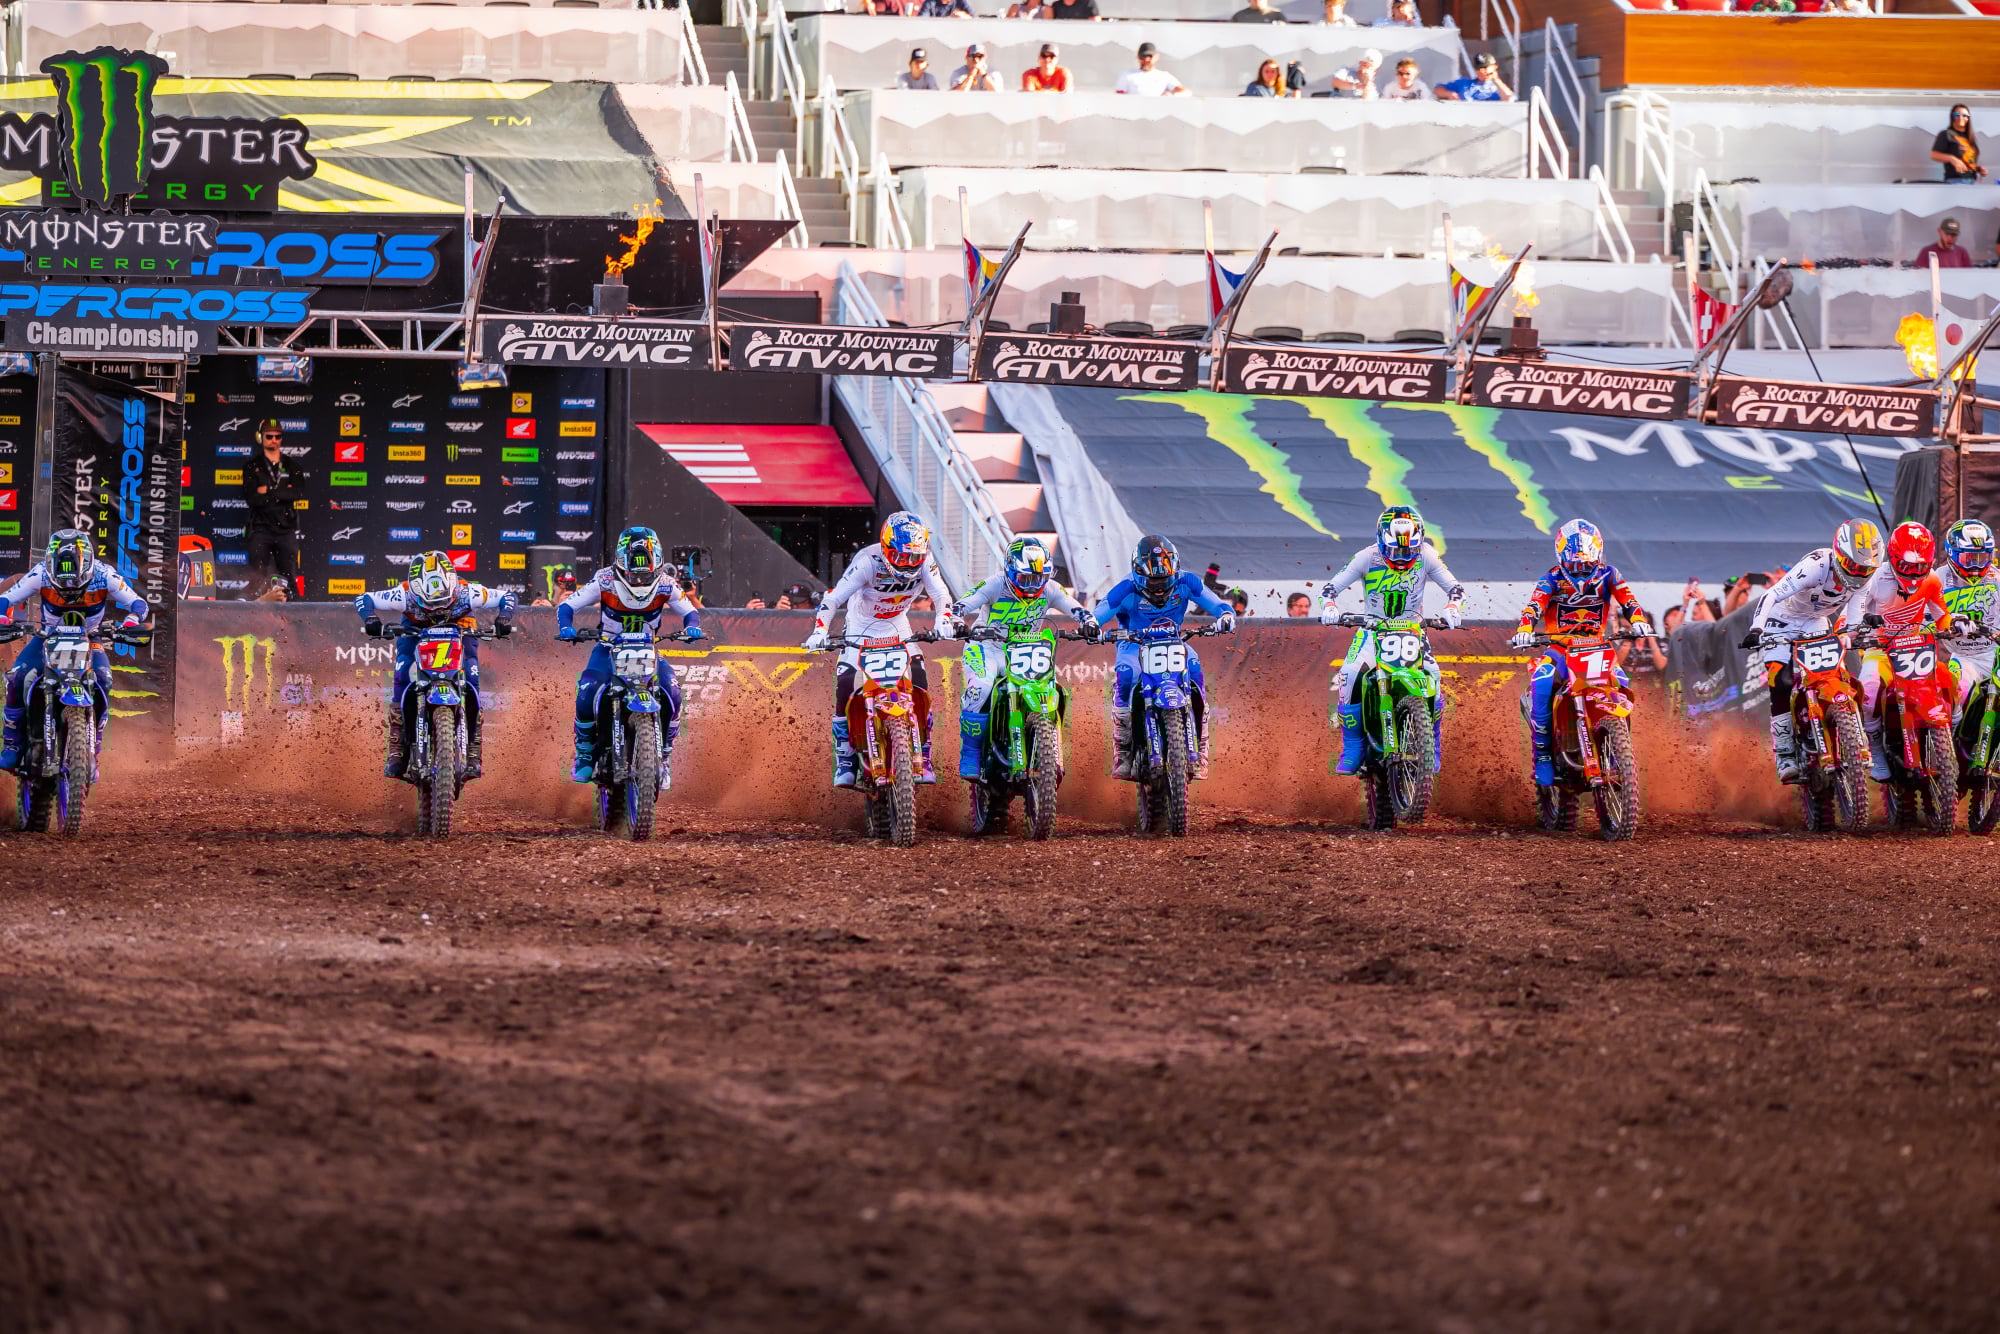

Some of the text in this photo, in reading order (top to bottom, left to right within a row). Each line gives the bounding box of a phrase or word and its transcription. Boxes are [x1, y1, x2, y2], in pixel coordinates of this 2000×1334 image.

[2, 125, 314, 170] MSTER
[6, 214, 213, 250] MONSTER
[39, 257, 180, 270] ENERGY
[0, 284, 312, 322] PERCROSS
[27, 321, 199, 352] Championship
[529, 322, 695, 342] ROCKY MOUNTAIN
[775, 329, 940, 352] ROCKY MOUNTAIN
[1023, 340, 1185, 364] ROCKY MOUNTAIN
[1271, 353, 1433, 377] ROCKY MOUNTAIN
[1517, 366, 1677, 393] ROCKY MOUNTAIN
[1762, 384, 1921, 411] ROCKY MOUNTAIN
[98, 477, 110, 556] NERGY
[386, 502, 417, 510] TRIUMPH
[147, 454, 167, 604] CHAMPIONSHIP
[1010, 646, 1051, 674] 56
[1141, 645, 1185, 674] 166
[1380, 635, 1420, 662] 98
[1803, 641, 1840, 671] 65
[865, 651, 908, 678] 23
[1896, 650, 1935, 678] 30
